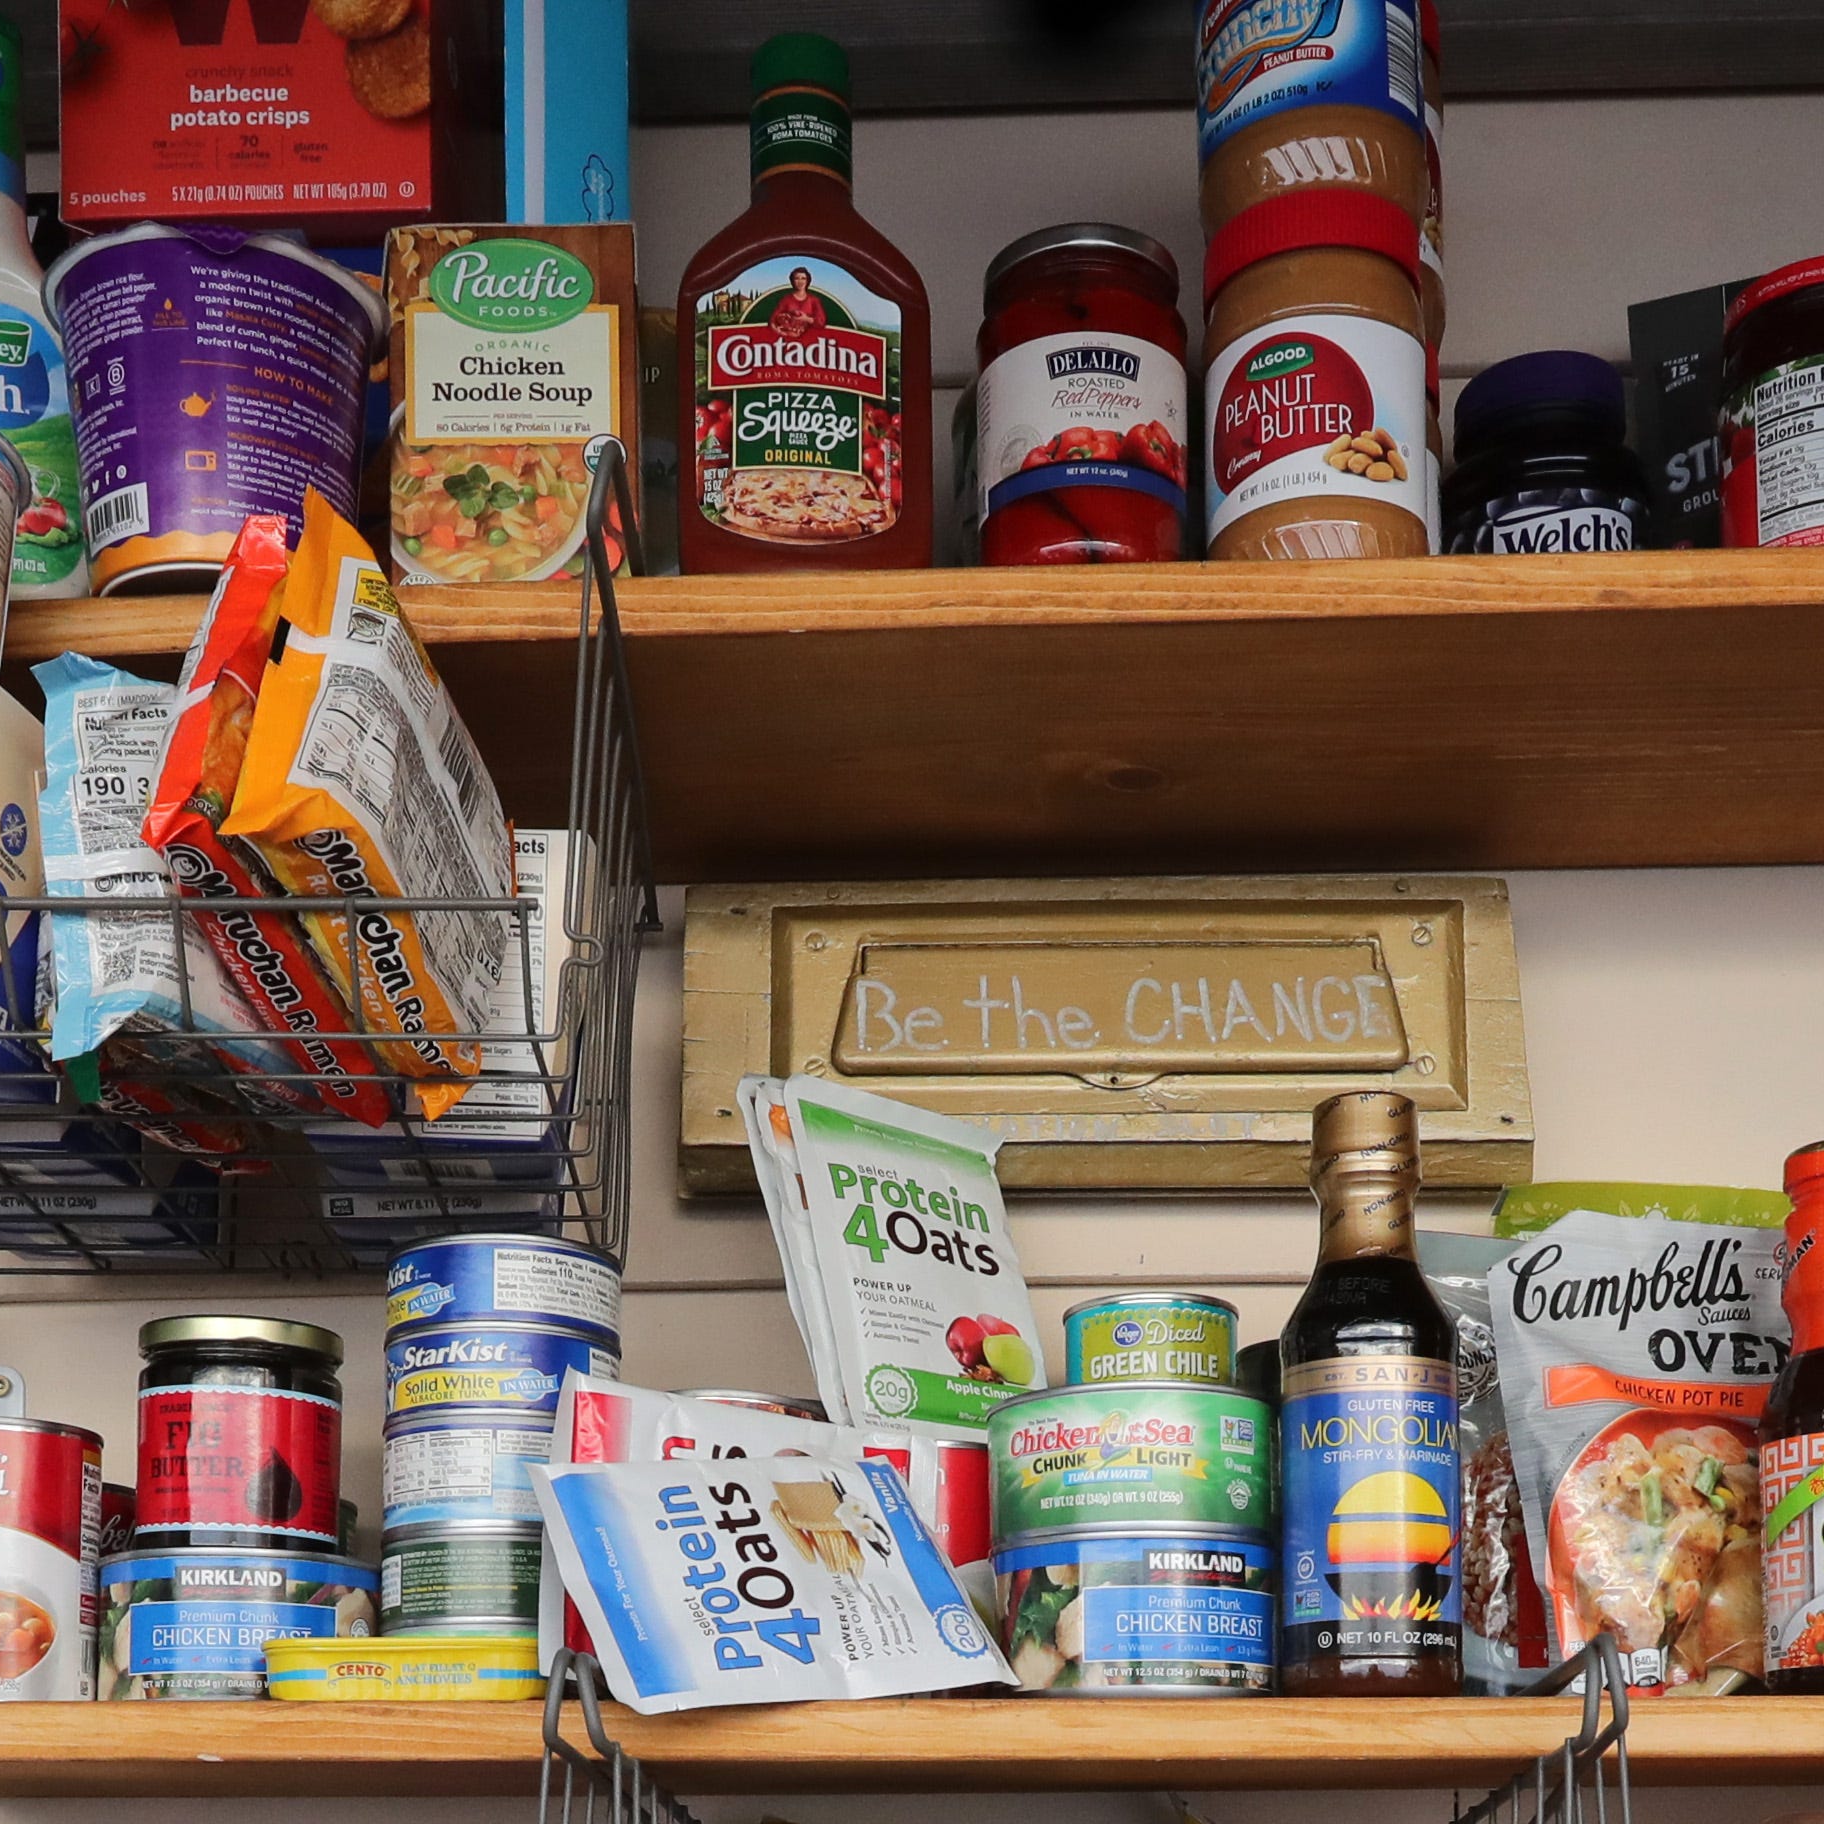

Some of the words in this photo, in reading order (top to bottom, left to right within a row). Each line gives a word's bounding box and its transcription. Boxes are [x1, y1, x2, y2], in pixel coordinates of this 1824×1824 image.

[190, 84, 288, 102] barbecue
[170, 109, 241, 130] potato
[246, 108, 310, 128] crisps
[445, 251, 581, 303] Pacific
[479, 305, 548, 318] FOODS
[475, 340, 551, 353] ORGANIC
[718, 334, 877, 378] Contadina
[460, 356, 565, 376] Chicken
[1052, 351, 1135, 375] DELALLO
[1250, 347, 1306, 373] ALGOOD
[433, 382, 522, 402] Noodle
[529, 382, 592, 405] Soup
[1067, 377, 1125, 389] ROASTED
[1757, 371, 1816, 402] Nutrition
[768, 392, 836, 410] PIZZA
[1225, 374, 1315, 432] PEANUT
[738, 401, 857, 449] Squeeze
[1086, 411, 1119, 419] WATER
[1261, 403, 1353, 444] BUTTER
[436, 423, 449, 431] 80
[451, 422, 490, 432] Calories
[515, 423, 551, 432] Protein
[574, 423, 591, 432] Fat
[765, 449, 832, 464] ORIGINAL
[1500, 514, 1629, 554] Welch's
[81, 776, 125, 797] 190
[854, 980, 950, 1054] Be
[965, 976, 1101, 1050] the
[1124, 976, 1392, 1045] CHANGE
[828, 1163, 990, 1234] Protein
[853, 1277, 894, 1291] POWER
[897, 1282, 912, 1293] UP
[1508, 1239, 1751, 1330] Campbell's
[1147, 1319, 1204, 1346] Diced
[404, 1339, 507, 1366] StarKist
[1091, 1354, 1154, 1379] GREEN
[1164, 1351, 1218, 1378] CHILE
[405, 1376, 438, 1397] Solid
[443, 1374, 495, 1392] White
[1615, 1380, 1678, 1403] CHICKEN
[1682, 1391, 1715, 1406] POT
[1720, 1391, 1744, 1407] PIE
[1347, 1399, 1402, 1412] GLUTEN
[1405, 1399, 1435, 1414] FREE
[1033, 1452, 1086, 1474] CHUNK
[1137, 1450, 1191, 1467] LIGHT
[1323, 1450, 1383, 1464] STIR-FRY
[1386, 1450, 1394, 1461] &
[1398, 1450, 1453, 1466] MARINADE
[1149, 1553, 1243, 1573] KIRKLAND
[182, 1568, 283, 1588] KIRKLAND
[1148, 1595, 1205, 1611] Premium
[1209, 1596, 1241, 1610] Chunk
[1116, 1614, 1202, 1633] CHICKEN
[1208, 1615, 1262, 1636] BREAST
[337, 1663, 385, 1677] CENTO
